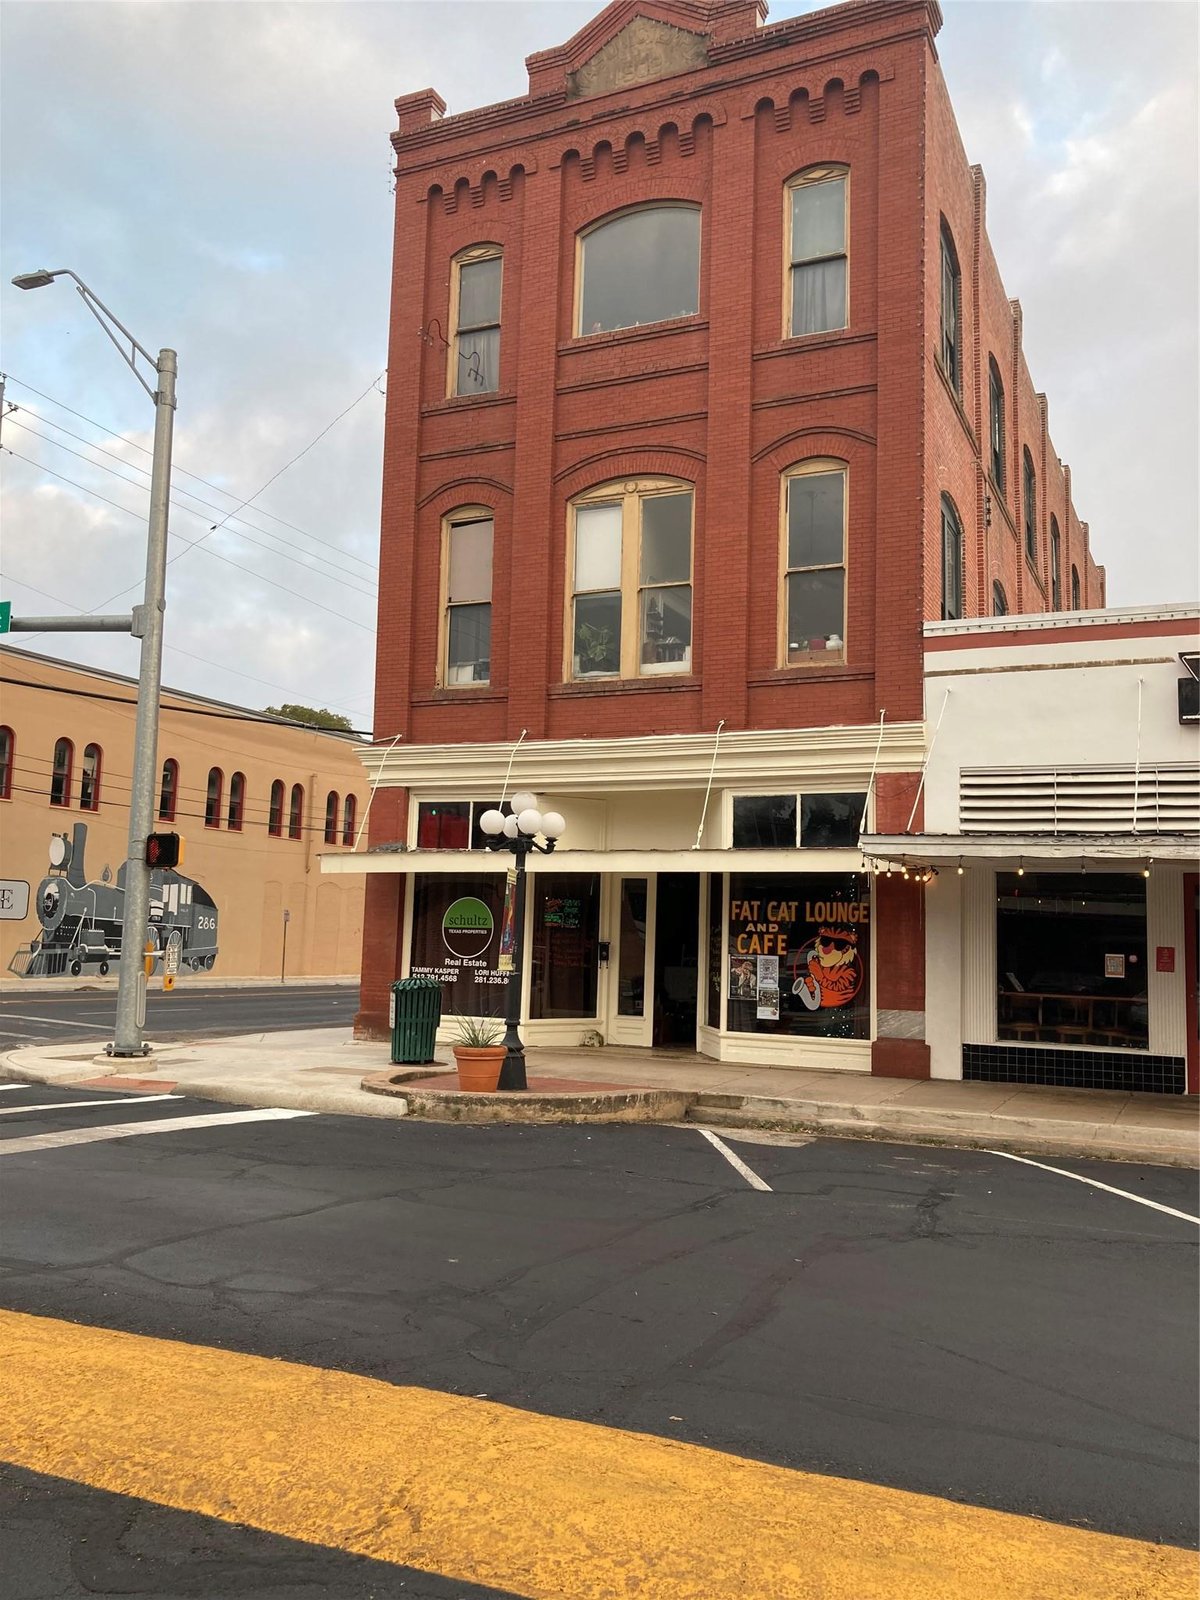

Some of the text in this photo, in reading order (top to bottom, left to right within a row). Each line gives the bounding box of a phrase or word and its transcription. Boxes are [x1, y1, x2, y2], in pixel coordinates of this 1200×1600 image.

[731, 900, 869, 923] FAT CAT LOUNGE
[197, 916, 216, 930] 286
[449, 914, 488, 926] schultz
[745, 923, 779, 933] AND
[737, 933, 788, 955] CAFE
[444, 958, 487, 967] Real Estate
[411, 966, 460, 975] TAMMY KASPER
